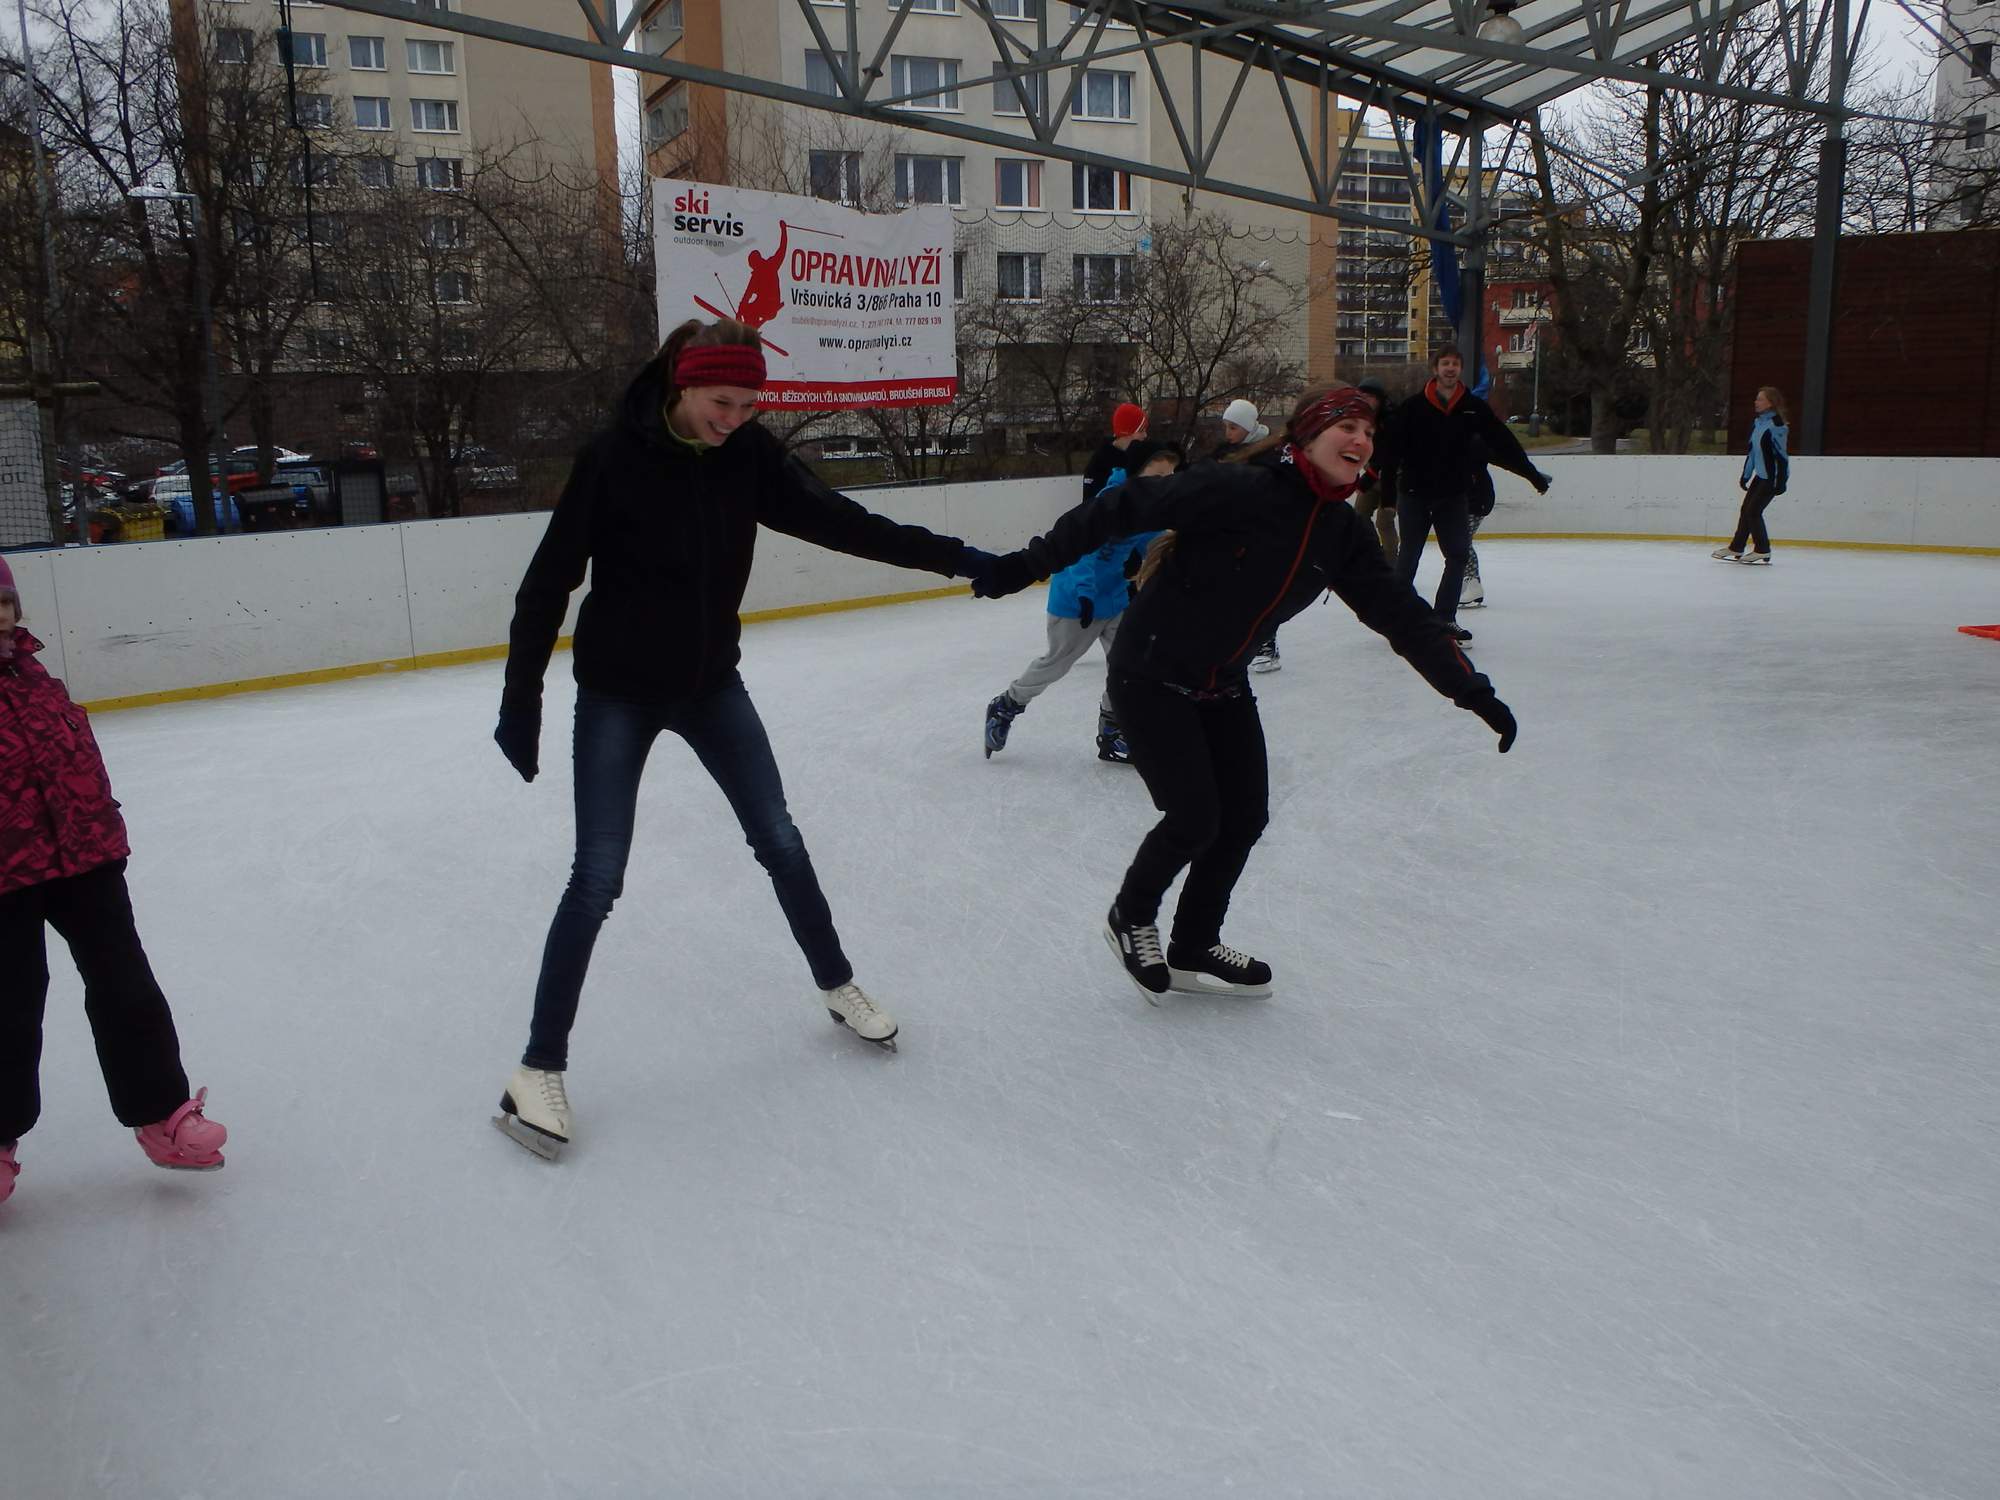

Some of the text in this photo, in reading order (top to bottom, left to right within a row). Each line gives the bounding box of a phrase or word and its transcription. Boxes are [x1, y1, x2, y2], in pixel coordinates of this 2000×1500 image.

[674, 189, 709, 215] ski
[674, 212, 744, 237] servis
[674, 236, 725, 248] outdoor team
[791, 288, 851, 309] Vršovická
[888, 293, 922, 309] Praha
[926, 291, 941, 308] 10
[905, 317, 916, 326] 777
[931, 316, 942, 326] 139
[819, 335, 912, 352] www.opravnalyzi.cz
[819, 390, 833, 403] LYŽÍ
[833, 392, 839, 403] A
[889, 386, 923, 400] BROUŠENÍ
[923, 385, 951, 398] BRUSLÍ
